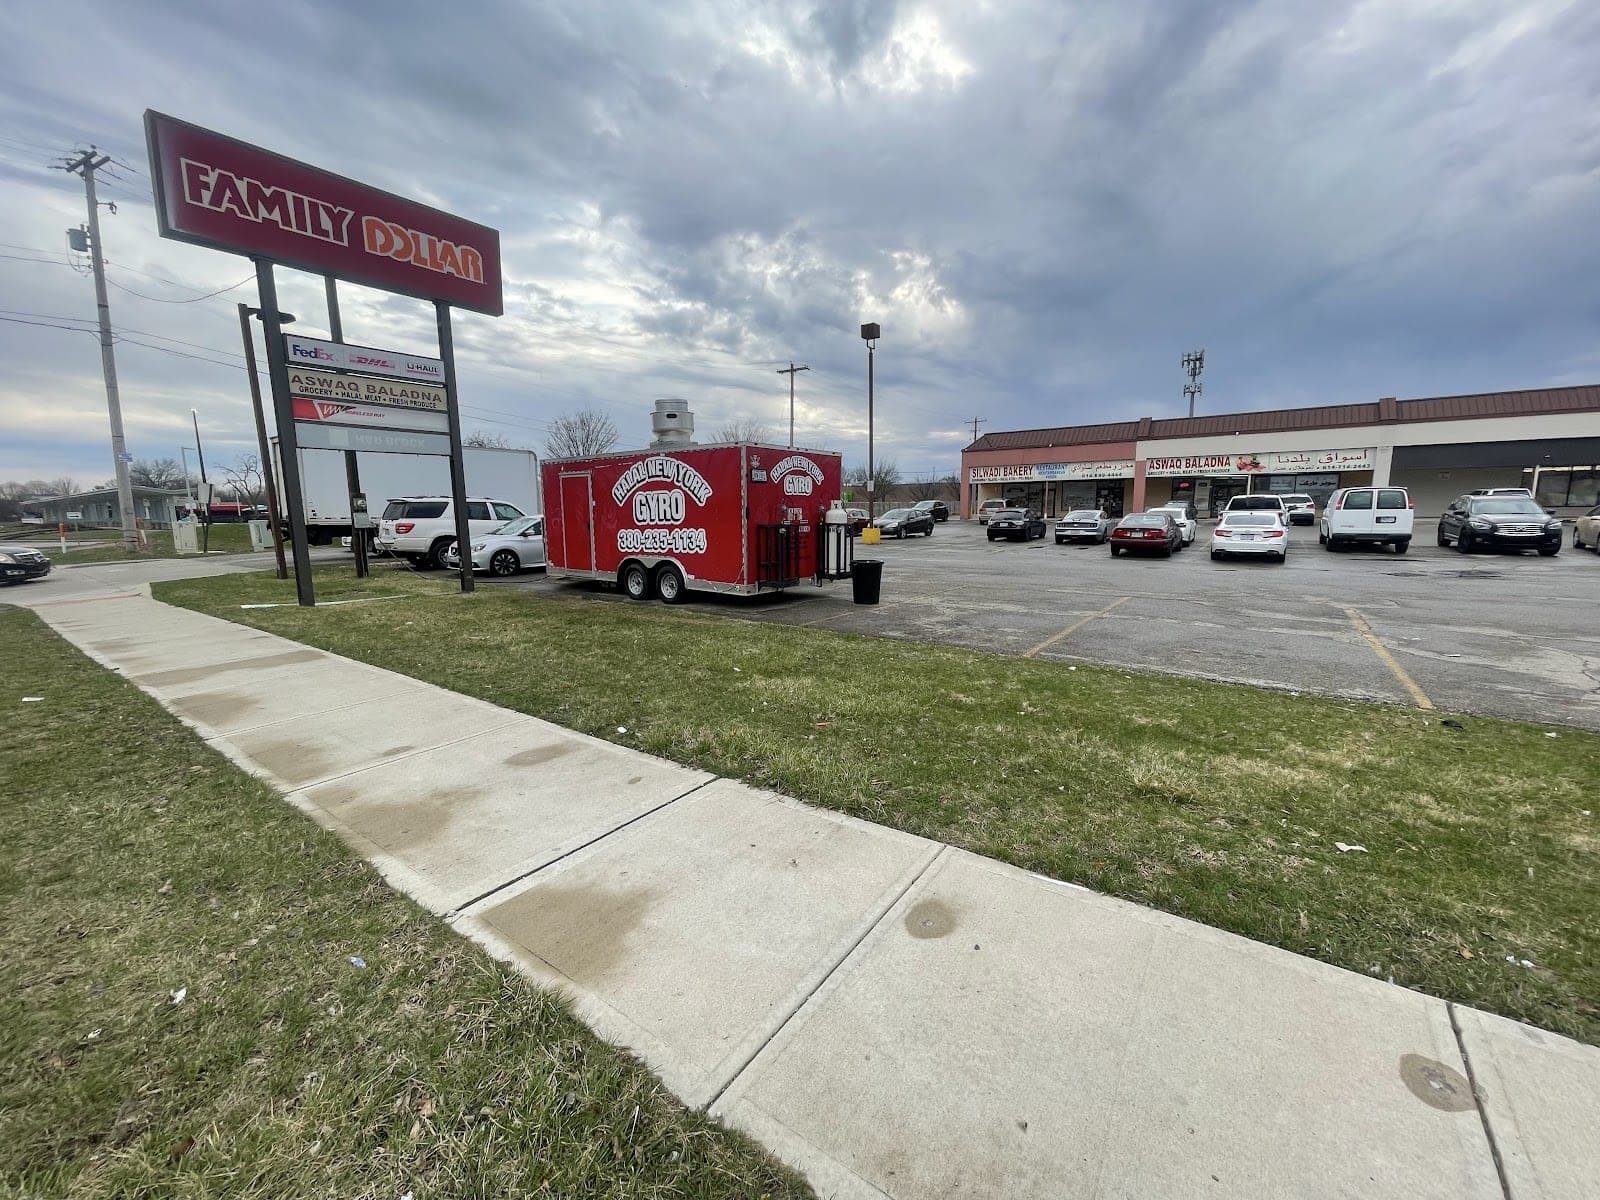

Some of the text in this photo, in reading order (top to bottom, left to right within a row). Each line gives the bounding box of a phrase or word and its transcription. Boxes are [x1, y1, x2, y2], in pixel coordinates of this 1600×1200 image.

[180, 157, 484, 284] FAMILY DOLLAR
[292, 344, 335, 361] FedEx
[353, 356, 391, 368] DHL
[291, 374, 442, 403] ASWAQ BALADNA
[299, 385, 437, 409] GROCERY HALAL MEAT FRESH PRODUCE
[972, 465, 1034, 478] SILWADI BAKERY
[1148, 456, 1231, 470] ASWAQ BALADNA
[613, 457, 712, 507] HALAL NEW YORK
[784, 475, 812, 495] GYRO
[634, 490, 685, 525] GYRO
[618, 529, 706, 553] 380-235-1134
